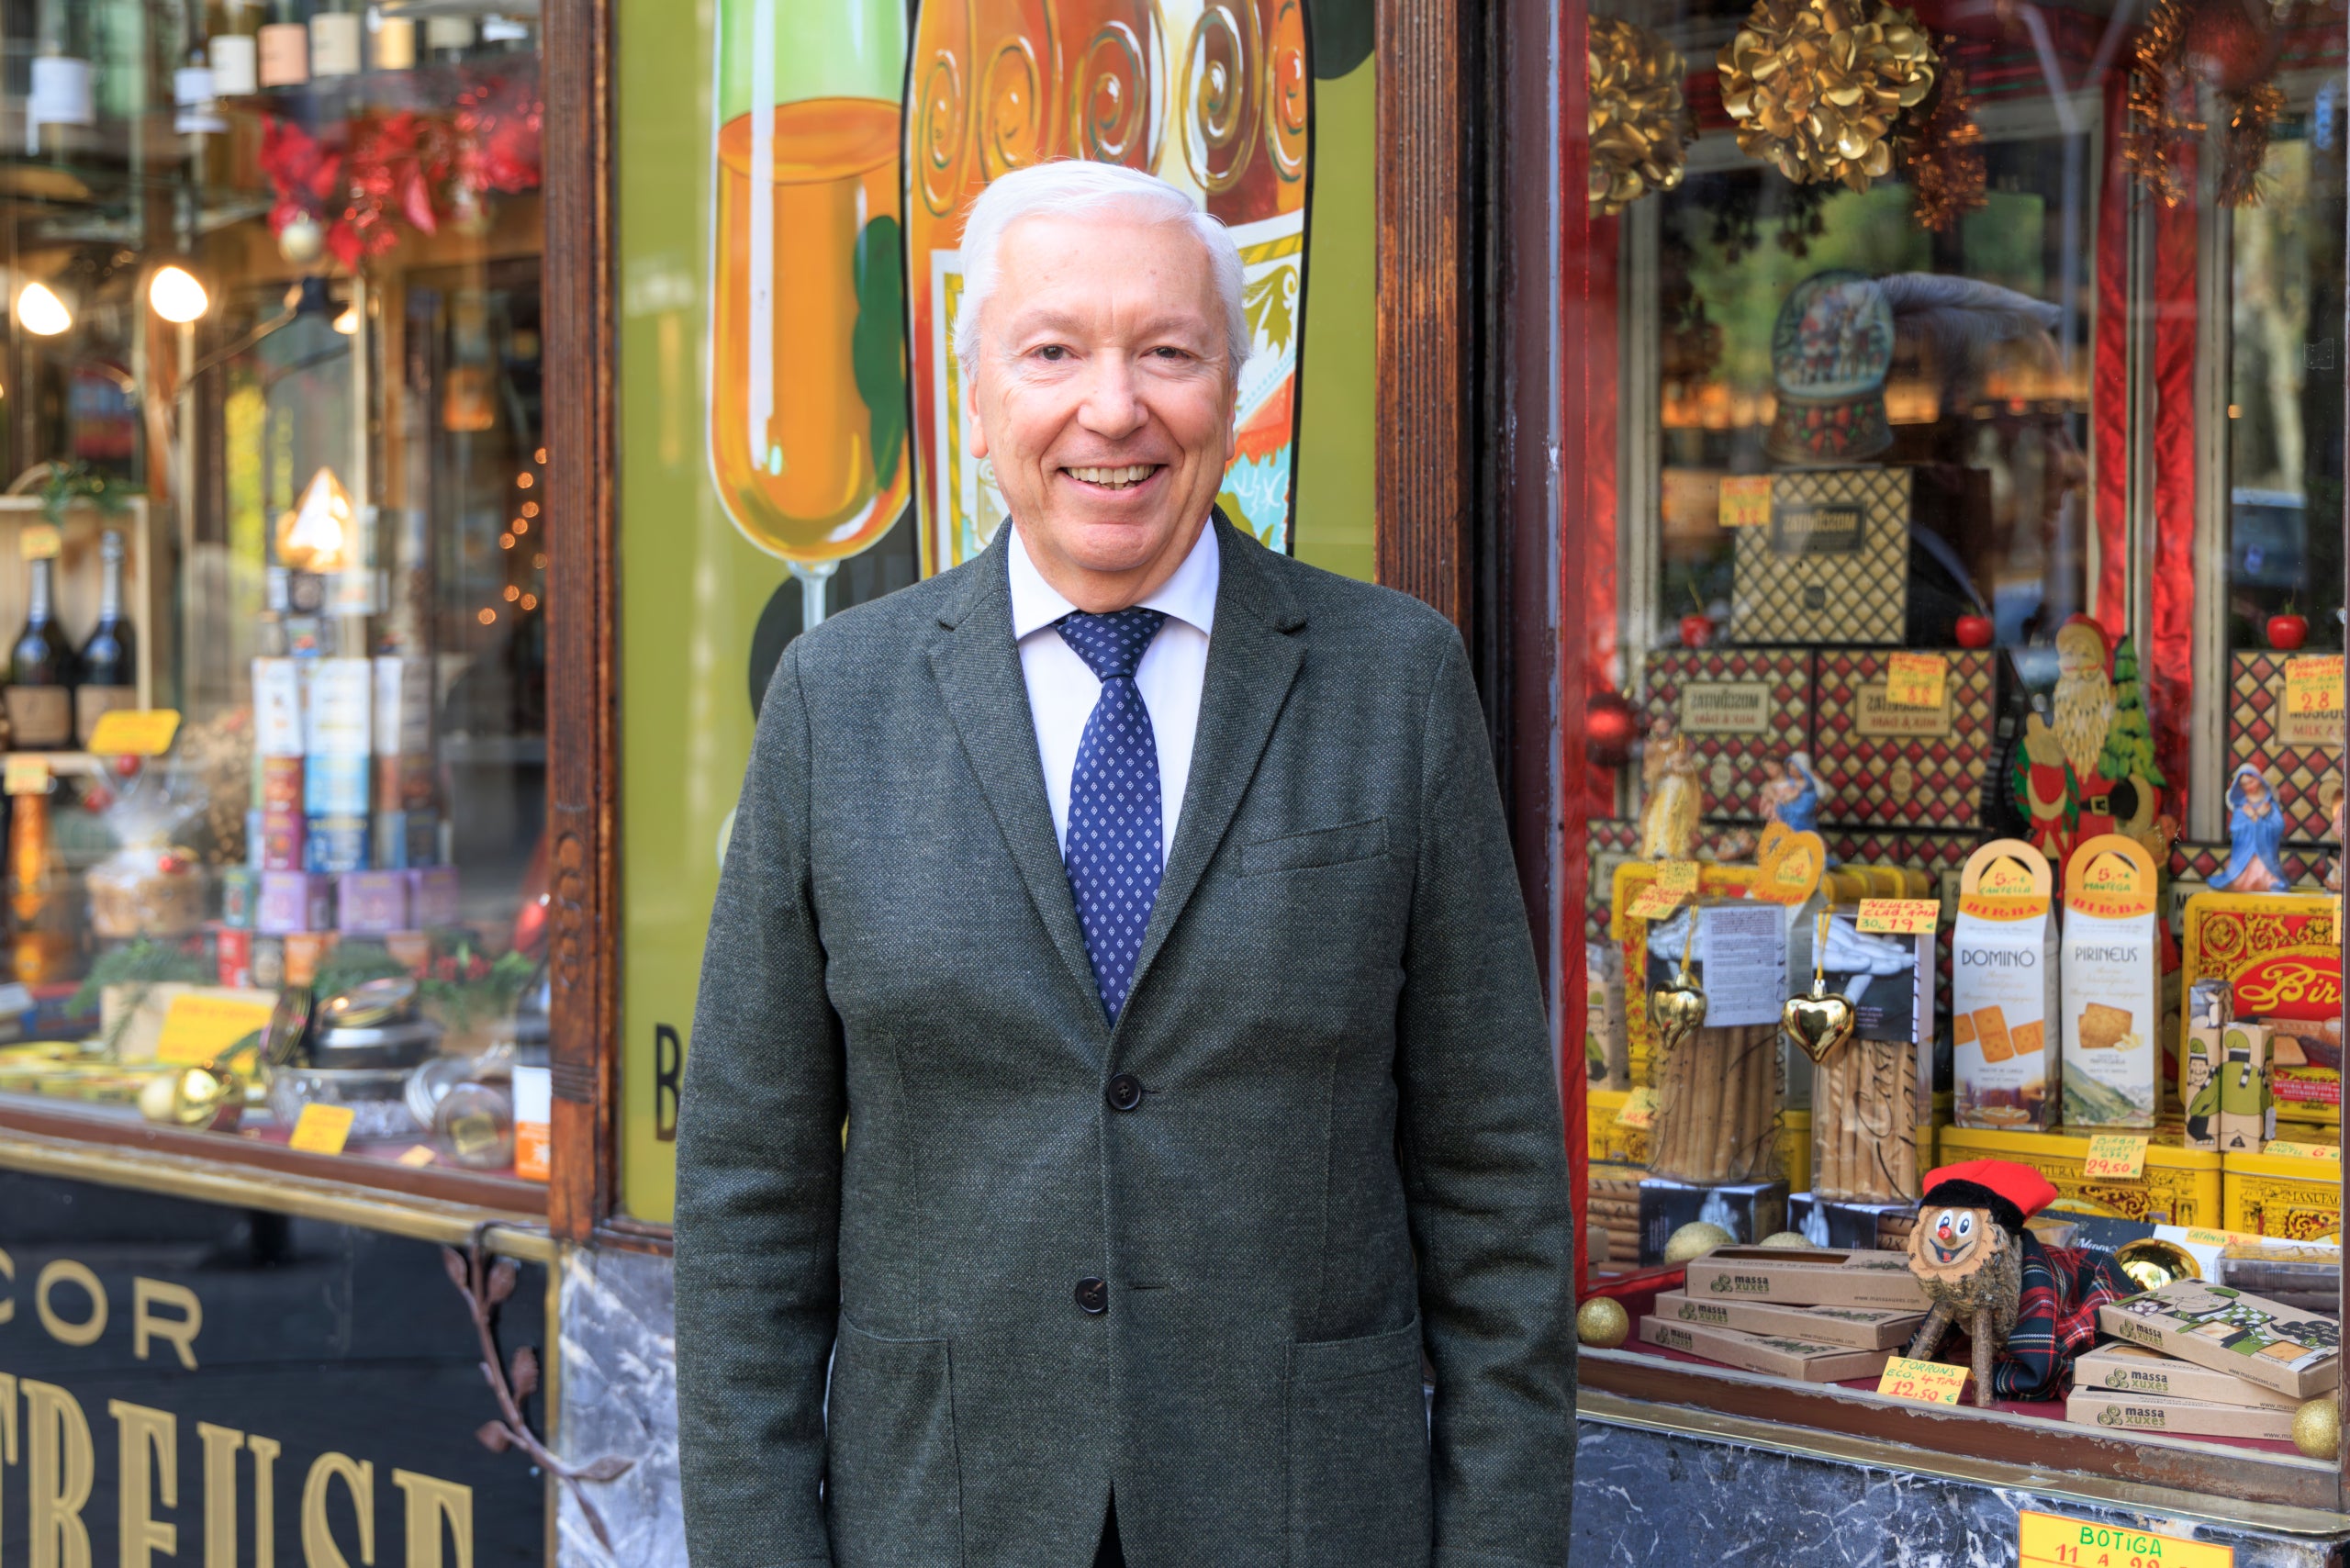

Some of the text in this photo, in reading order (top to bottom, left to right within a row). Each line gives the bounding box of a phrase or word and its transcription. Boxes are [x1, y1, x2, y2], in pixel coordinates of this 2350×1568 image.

[2300, 691, 2330, 711] 28
[1966, 902, 2039, 917] BIRBA
[2073, 897, 2146, 915] BIRBA
[1888, 918, 1914, 932] 19
[1962, 946, 2035, 968] DOMINÓ
[2075, 946, 2138, 963] PIRINEUS
[2238, 963, 2341, 1011] Bir
[2087, 1159, 2131, 1174] 29,50
[1734, 1275, 1769, 1284] massa
[1735, 1282, 1770, 1292] xuxes
[0, 1247, 203, 1371] OR
[1698, 1304, 1727, 1316] massa
[1699, 1312, 1729, 1323] xuxes
[1670, 1328, 1692, 1341] massa
[2136, 1323, 2162, 1339] massa
[2137, 1332, 2164, 1348] xuxes
[1886, 1368, 1915, 1380] ECO.
[1921, 1373, 1933, 1384] 4
[1899, 1360, 1956, 1377] TORRONS
[2132, 1371, 2168, 1383] massa
[1888, 1381, 1957, 1403] 12,50 €
[2132, 1380, 2169, 1391] xuxes
[2125, 1406, 2165, 1418] massa
[2125, 1416, 2165, 1426] xuxes
[2055, 1543, 2078, 1563] 11
[2098, 1553, 2109, 1567] A
